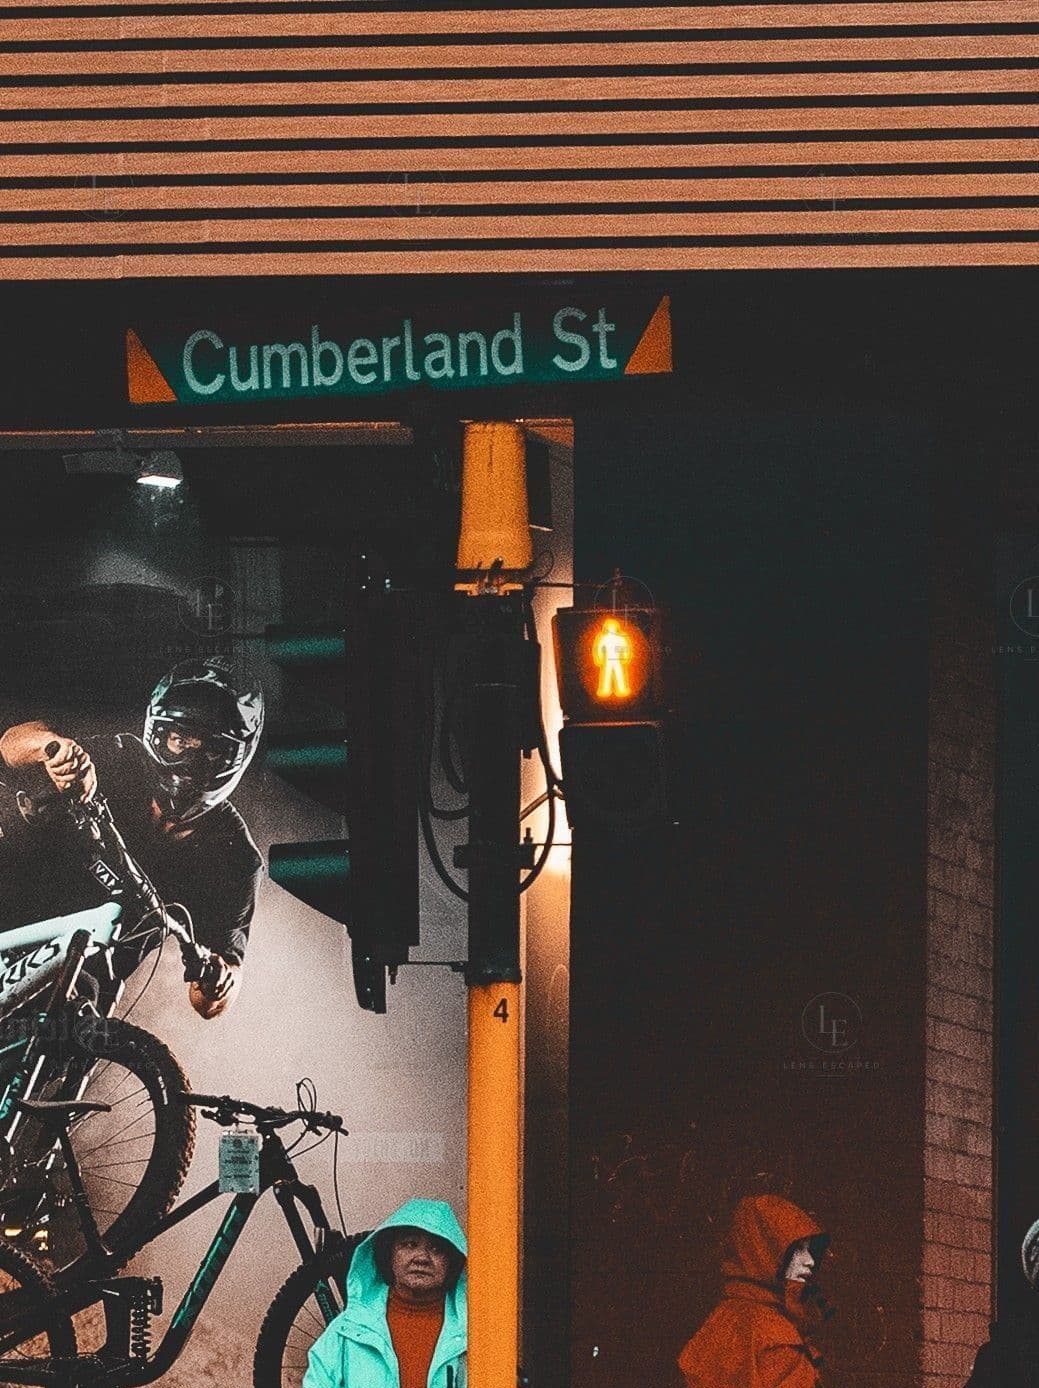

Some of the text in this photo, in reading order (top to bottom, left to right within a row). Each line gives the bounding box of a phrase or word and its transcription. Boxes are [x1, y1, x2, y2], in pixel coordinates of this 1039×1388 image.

[182, 306, 618, 396] Cumberland St
[493, 997, 509, 1023] 4
